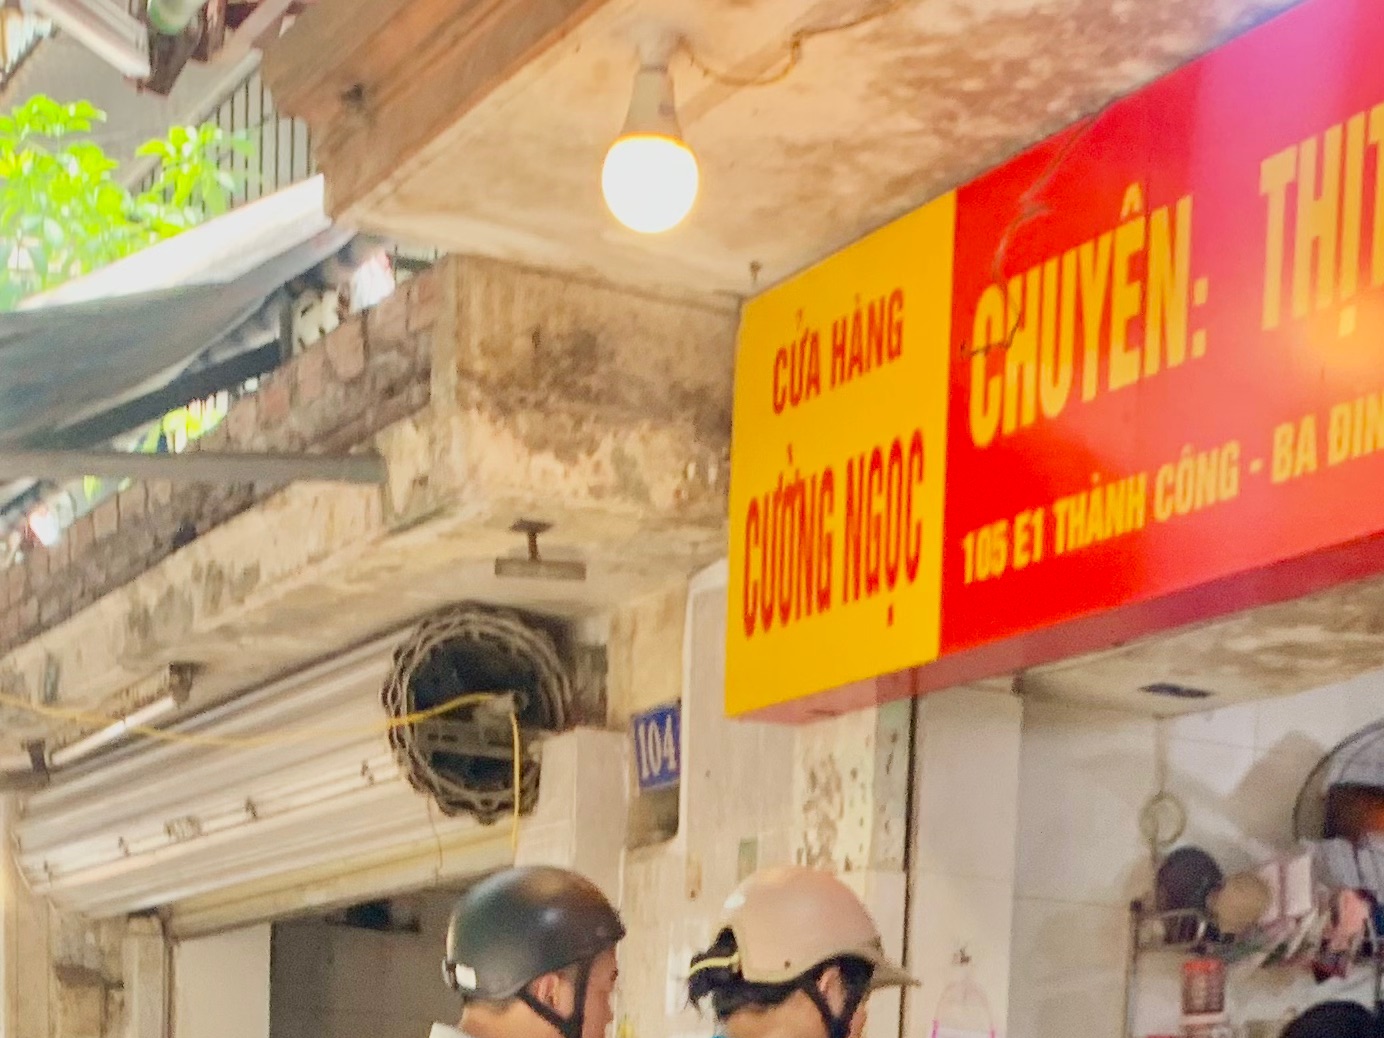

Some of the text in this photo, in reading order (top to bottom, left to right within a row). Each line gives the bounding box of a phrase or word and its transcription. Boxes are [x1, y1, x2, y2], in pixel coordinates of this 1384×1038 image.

[969, 181, 1209, 448] CHUYÊN:
[842, 428, 925, 627] NGỌC
[963, 519, 1009, 585] 105
[1013, 506, 1046, 571] E1
[1153, 443, 1242, 523] CÔNG
[1271, 414, 1318, 486] BA
[638, 714, 678, 779] 104
